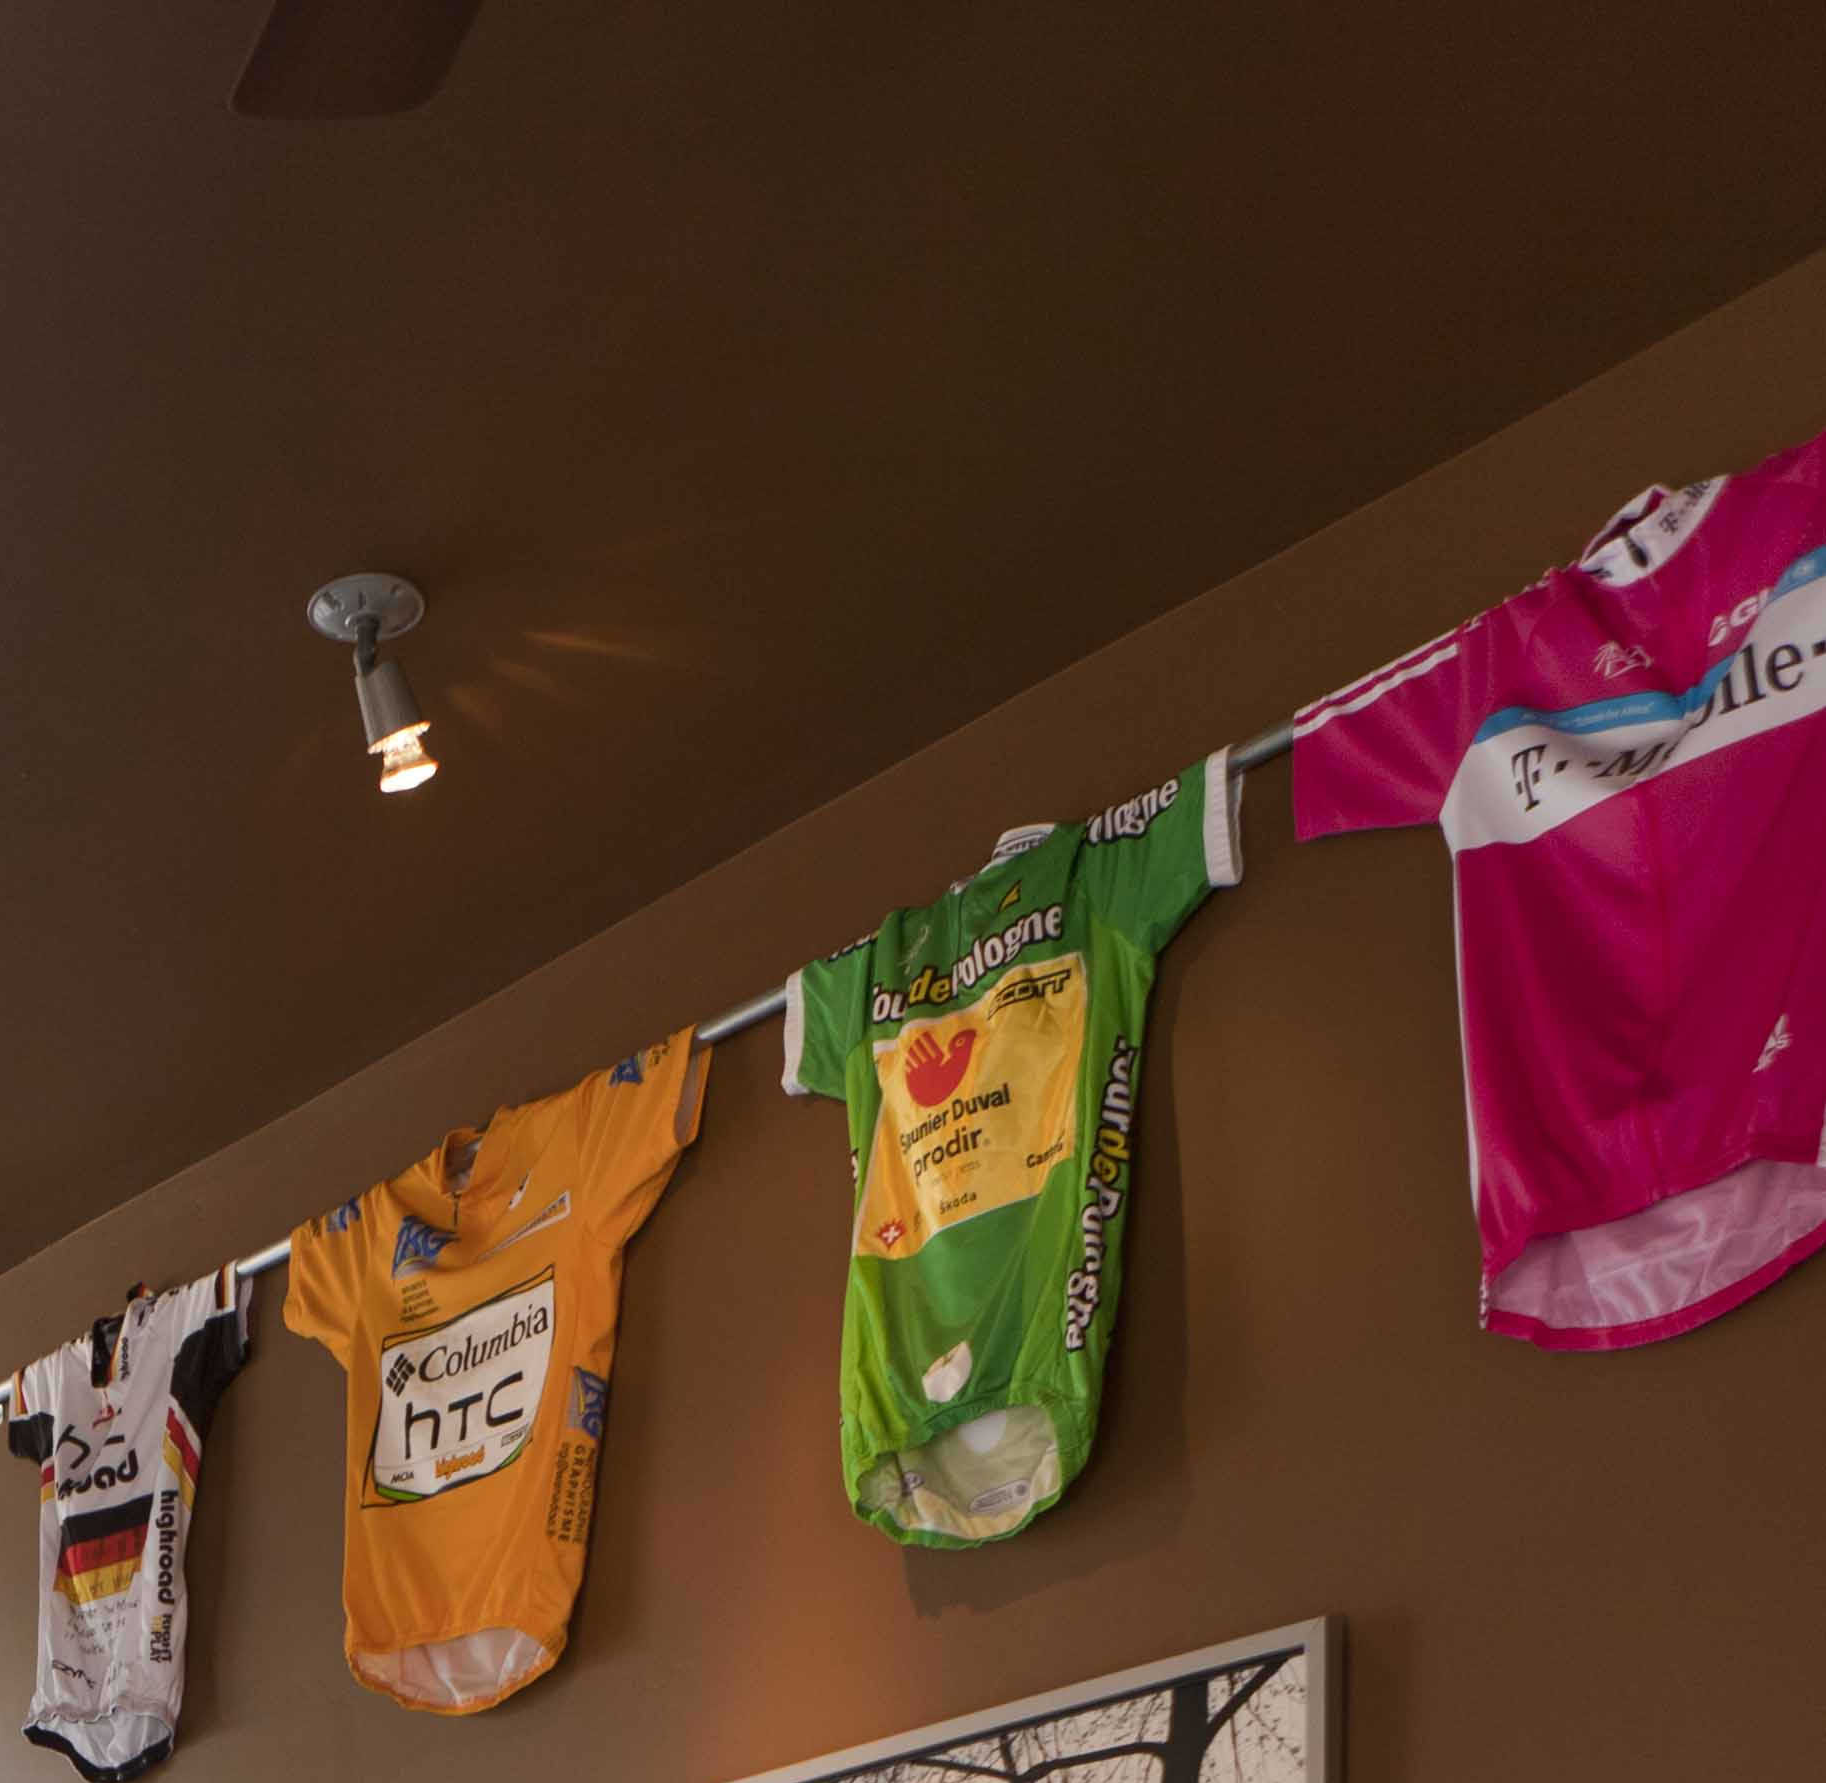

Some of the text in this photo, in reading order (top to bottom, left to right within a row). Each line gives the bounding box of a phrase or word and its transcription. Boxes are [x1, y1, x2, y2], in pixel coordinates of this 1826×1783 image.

[899, 1083, 1011, 1155] Saunier Duval
[914, 1126, 984, 1187] prodir
[418, 1303, 549, 1383] Columbia
[155, 1489, 179, 1605] highroad
